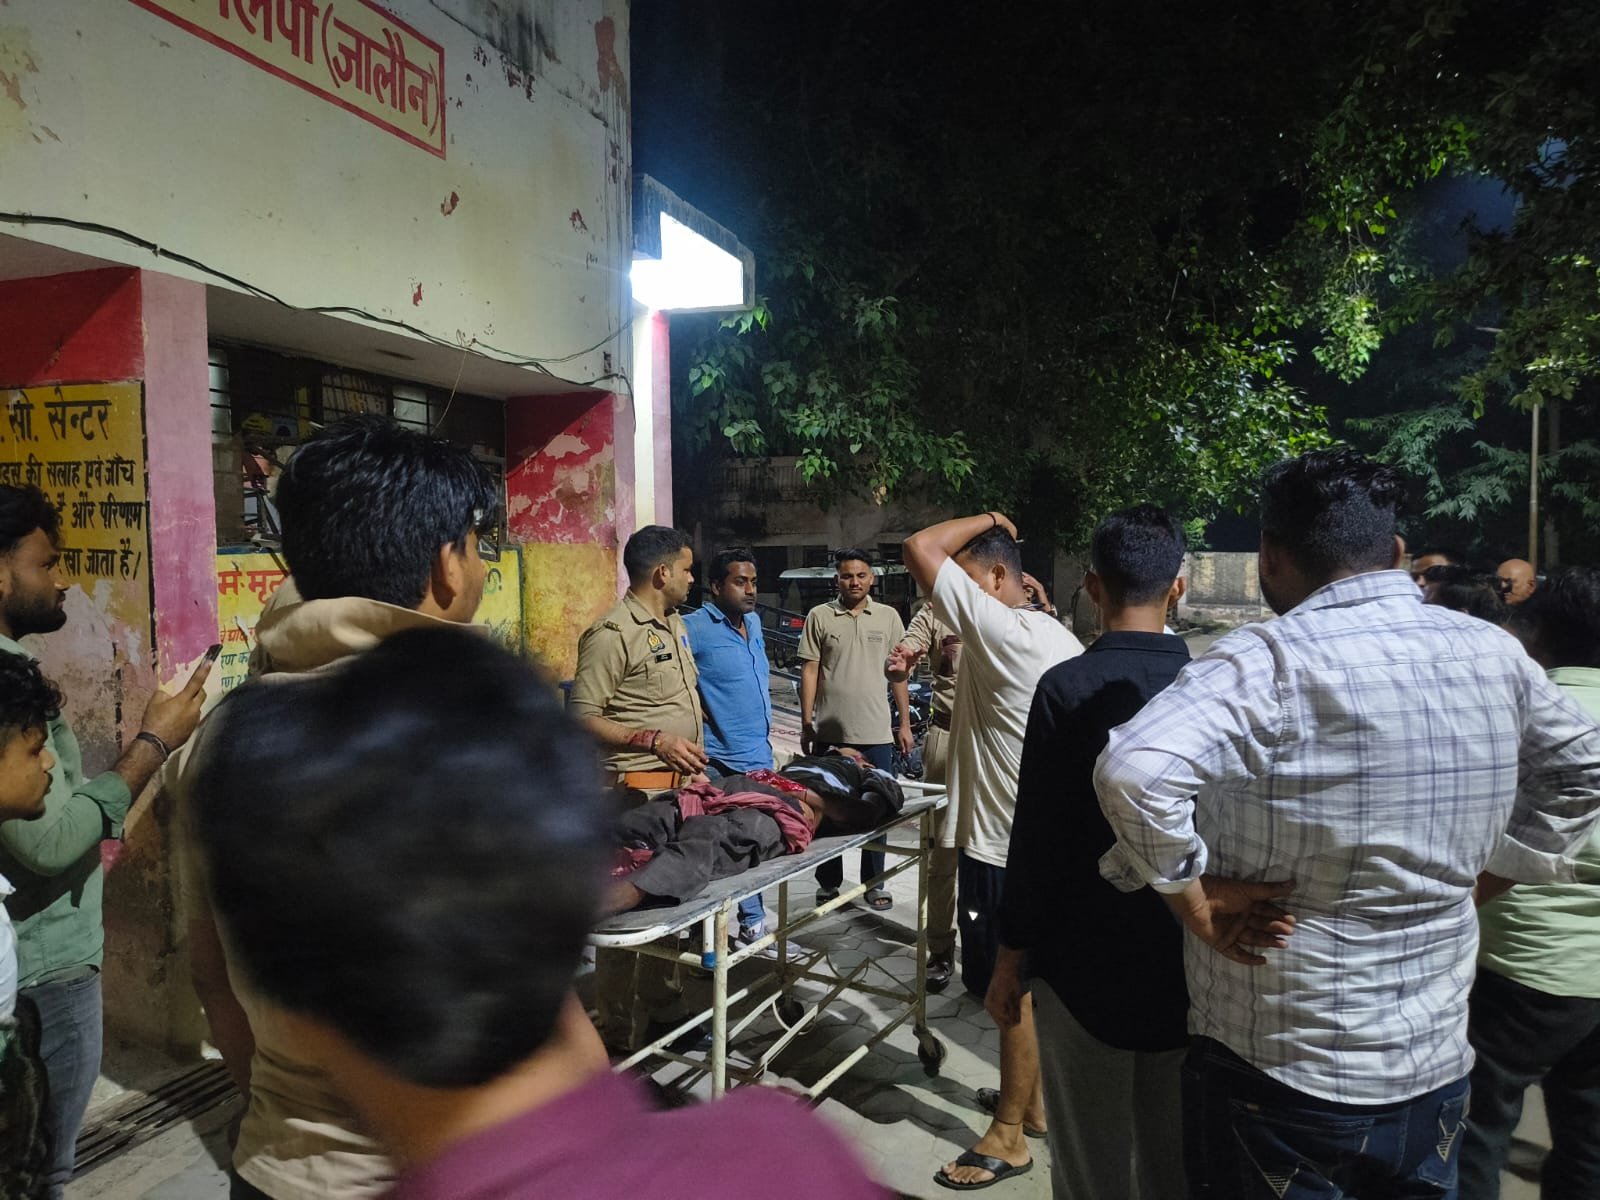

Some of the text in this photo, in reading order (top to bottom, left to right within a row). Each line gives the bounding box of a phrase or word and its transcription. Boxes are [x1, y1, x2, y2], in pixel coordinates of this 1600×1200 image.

[47, 461, 81, 489] सलाह
[71, 491, 96, 528] और
[85, 548, 117, 576] जाता
